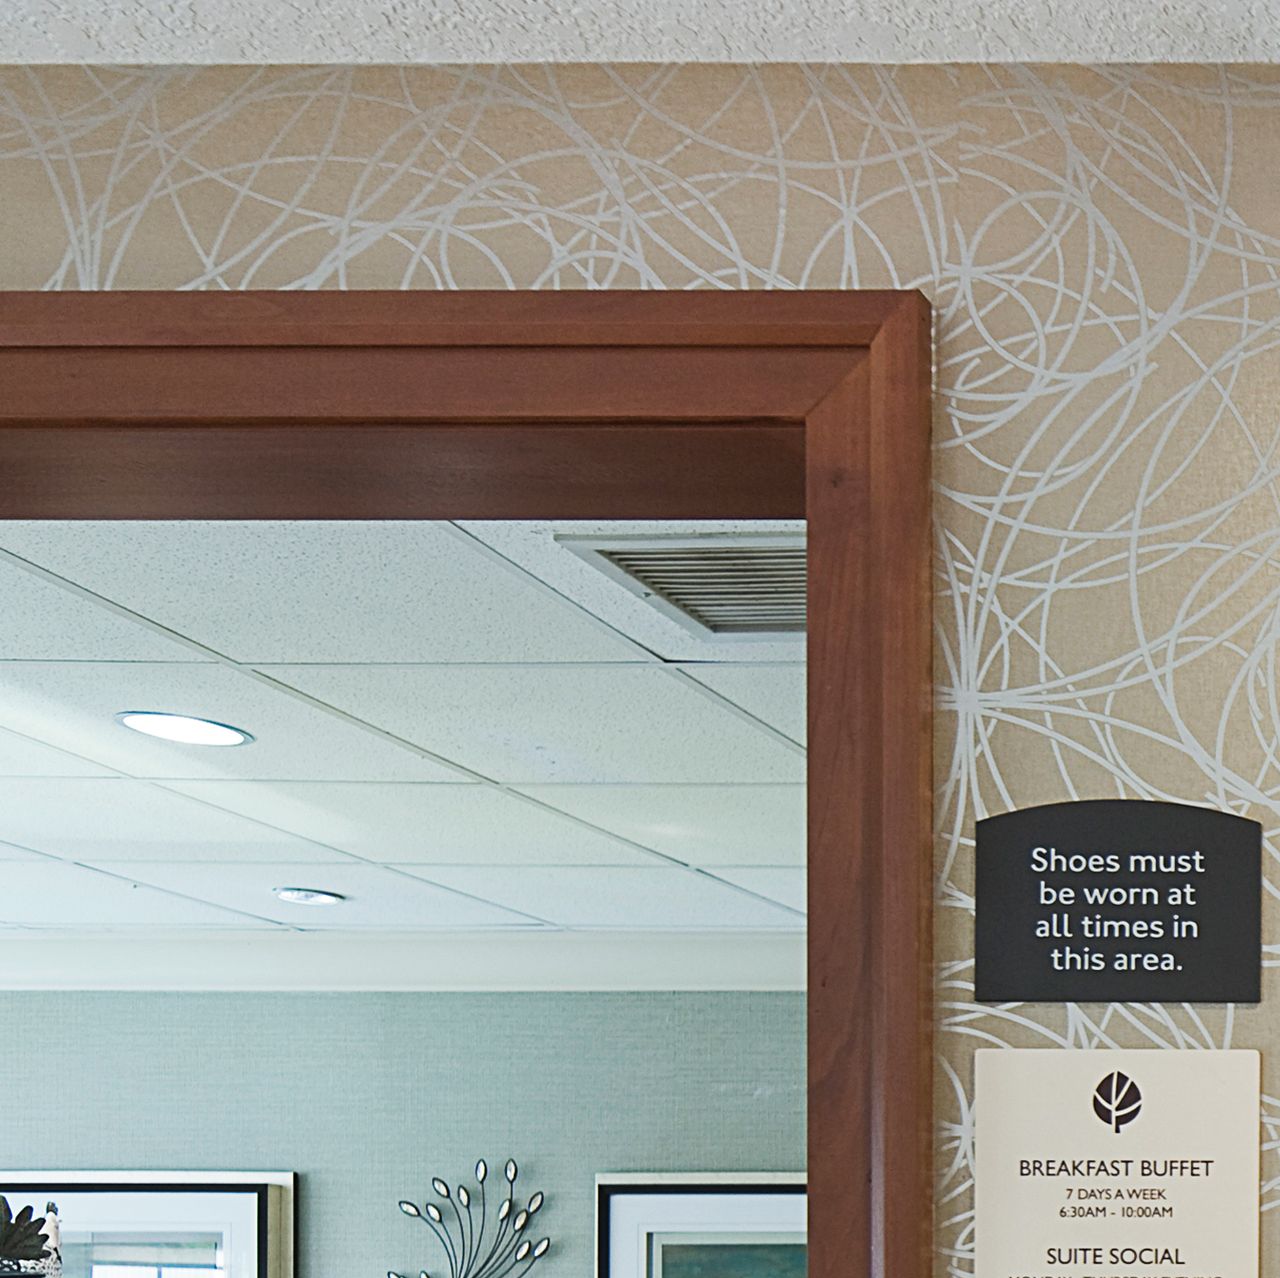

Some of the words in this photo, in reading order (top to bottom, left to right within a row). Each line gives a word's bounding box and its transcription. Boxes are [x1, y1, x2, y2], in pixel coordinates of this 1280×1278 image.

[1031, 847, 1120, 873] Shoes
[1129, 850, 1206, 873] must
[1040, 881, 1075, 905] be
[1083, 887, 1159, 905] worn
[1168, 883, 1197, 905] at
[1036, 914, 1073, 938] all
[1081, 914, 1164, 938] times
[1173, 914, 1199, 938] in
[1051, 946, 1105, 970] this
[1114, 952, 1183, 971] area.
[1019, 1159, 1134, 1177] BREAKFAST
[1141, 1160, 1214, 1177] BUFFET
[1066, 1188, 1073, 1200] 7
[1078, 1188, 1114, 1201] DAYS
[1114, 1189, 1125, 1201] A
[1127, 1188, 1167, 1201] WEEK
[1059, 1206, 1107, 1218] 6:30AM
[1121, 1206, 1173, 1218] 10:00AM
[1046, 1248, 1103, 1265] SUITE
[1109, 1248, 1186, 1265] SOCIAL
